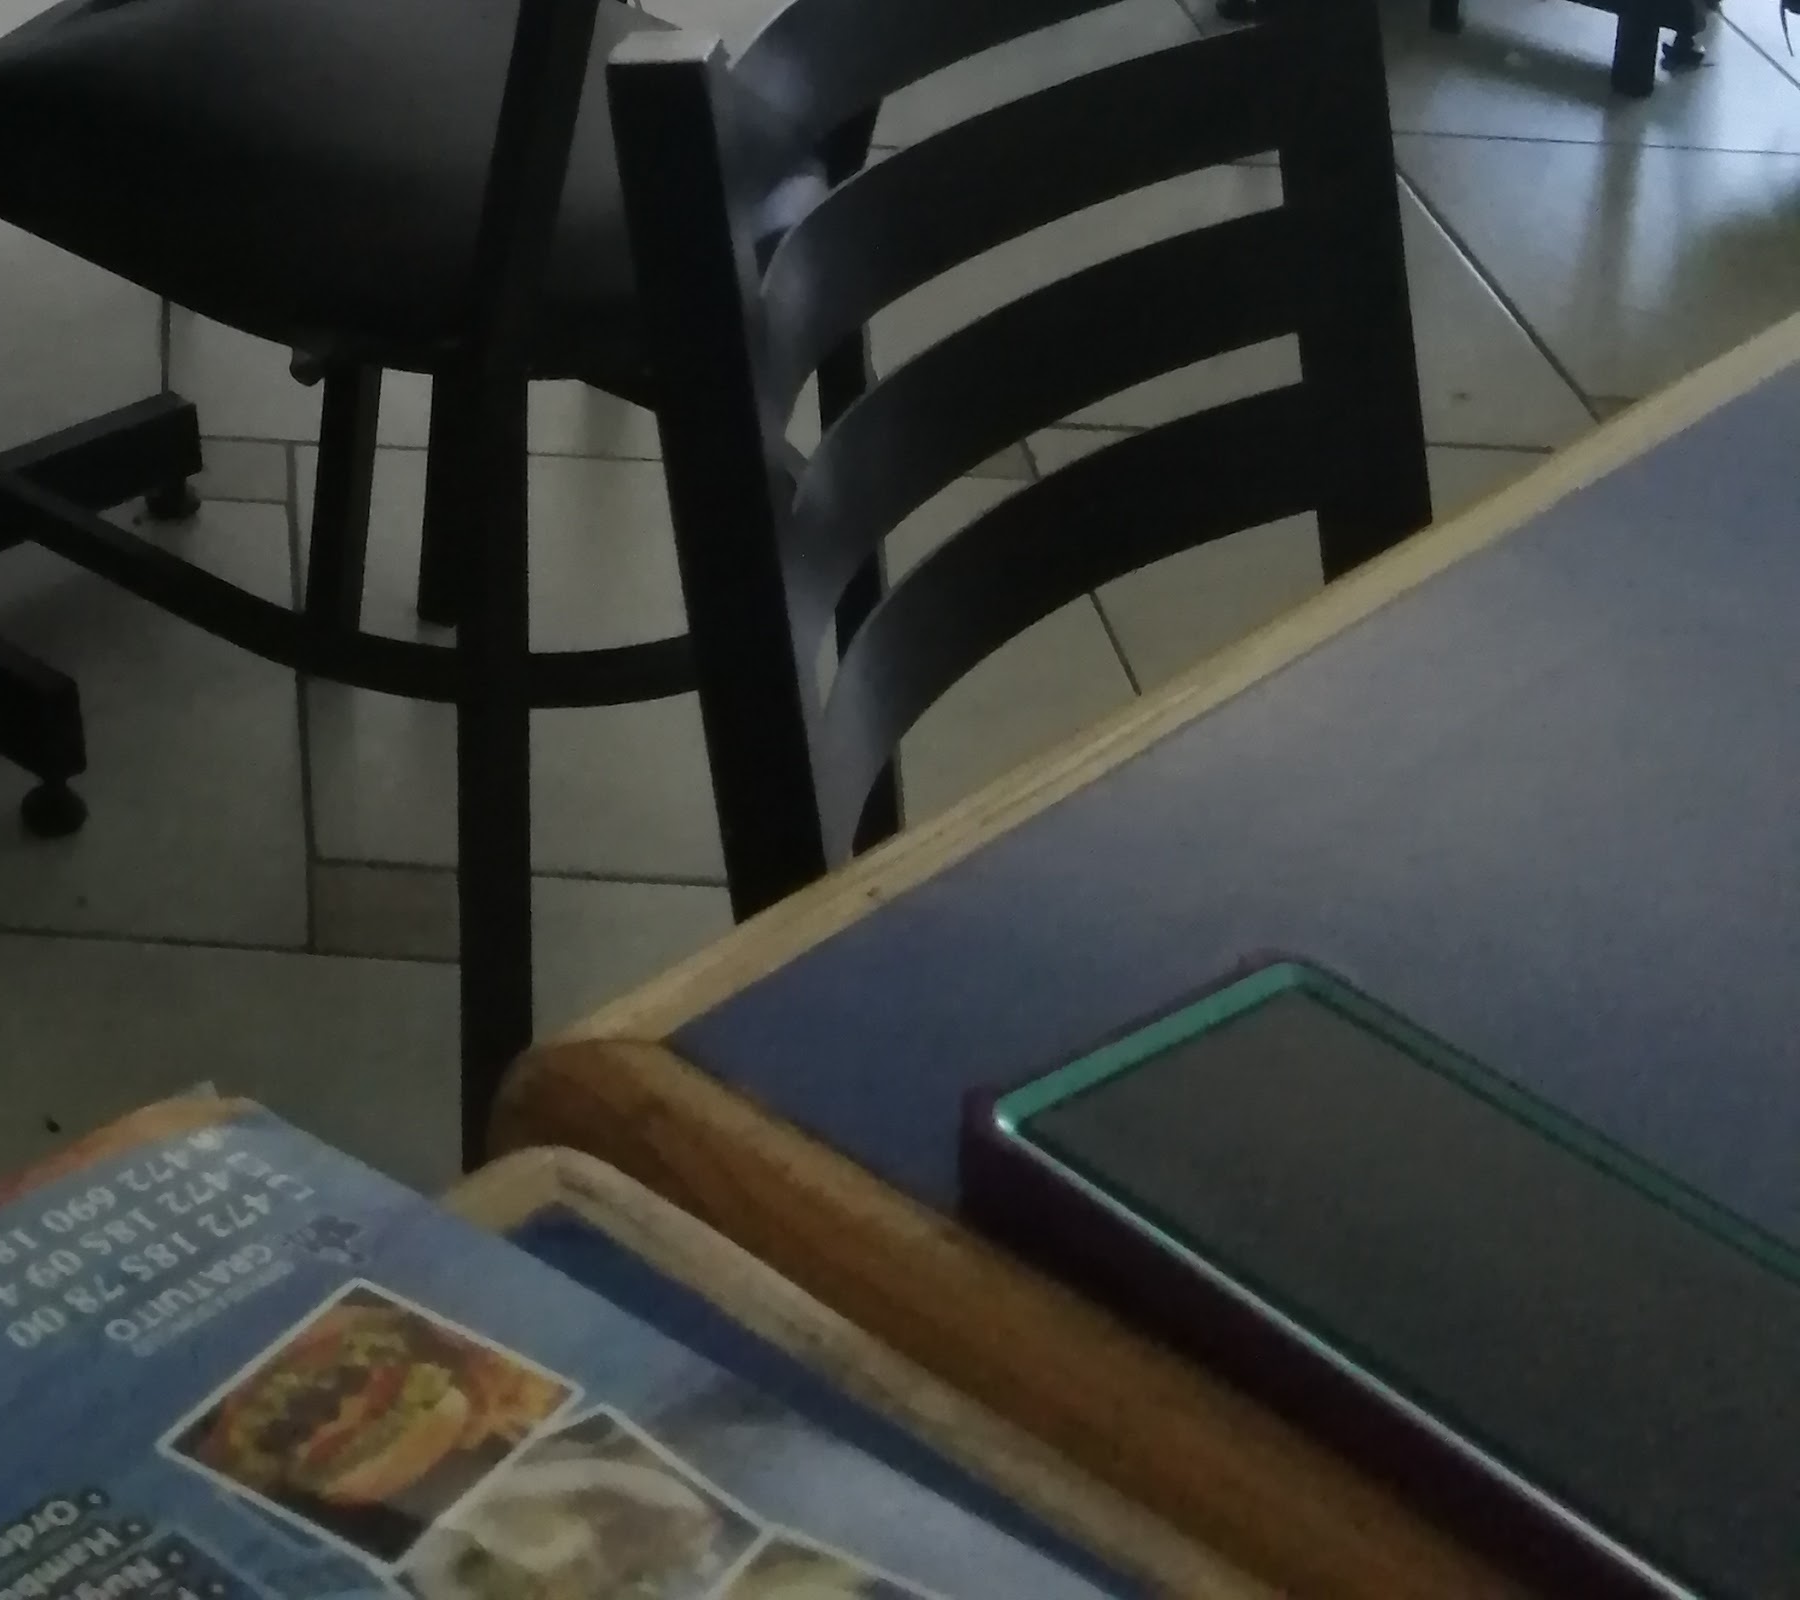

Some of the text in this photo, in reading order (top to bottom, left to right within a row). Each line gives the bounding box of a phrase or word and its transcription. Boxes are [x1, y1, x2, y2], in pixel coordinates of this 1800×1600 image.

[116, 1148, 195, 1191] 472
[157, 1169, 231, 1214] 472
[41, 1186, 116, 1234] 690
[80, 1207, 158, 1256] 185
[197, 1192, 271, 1238] 472
[25, 1248, 83, 1289] 09
[120, 1231, 198, 1282] 185
[64, 1274, 126, 1314] 78
[104, 1242, 273, 1342] GRATUITO
[6, 1305, 67, 1349] 00
